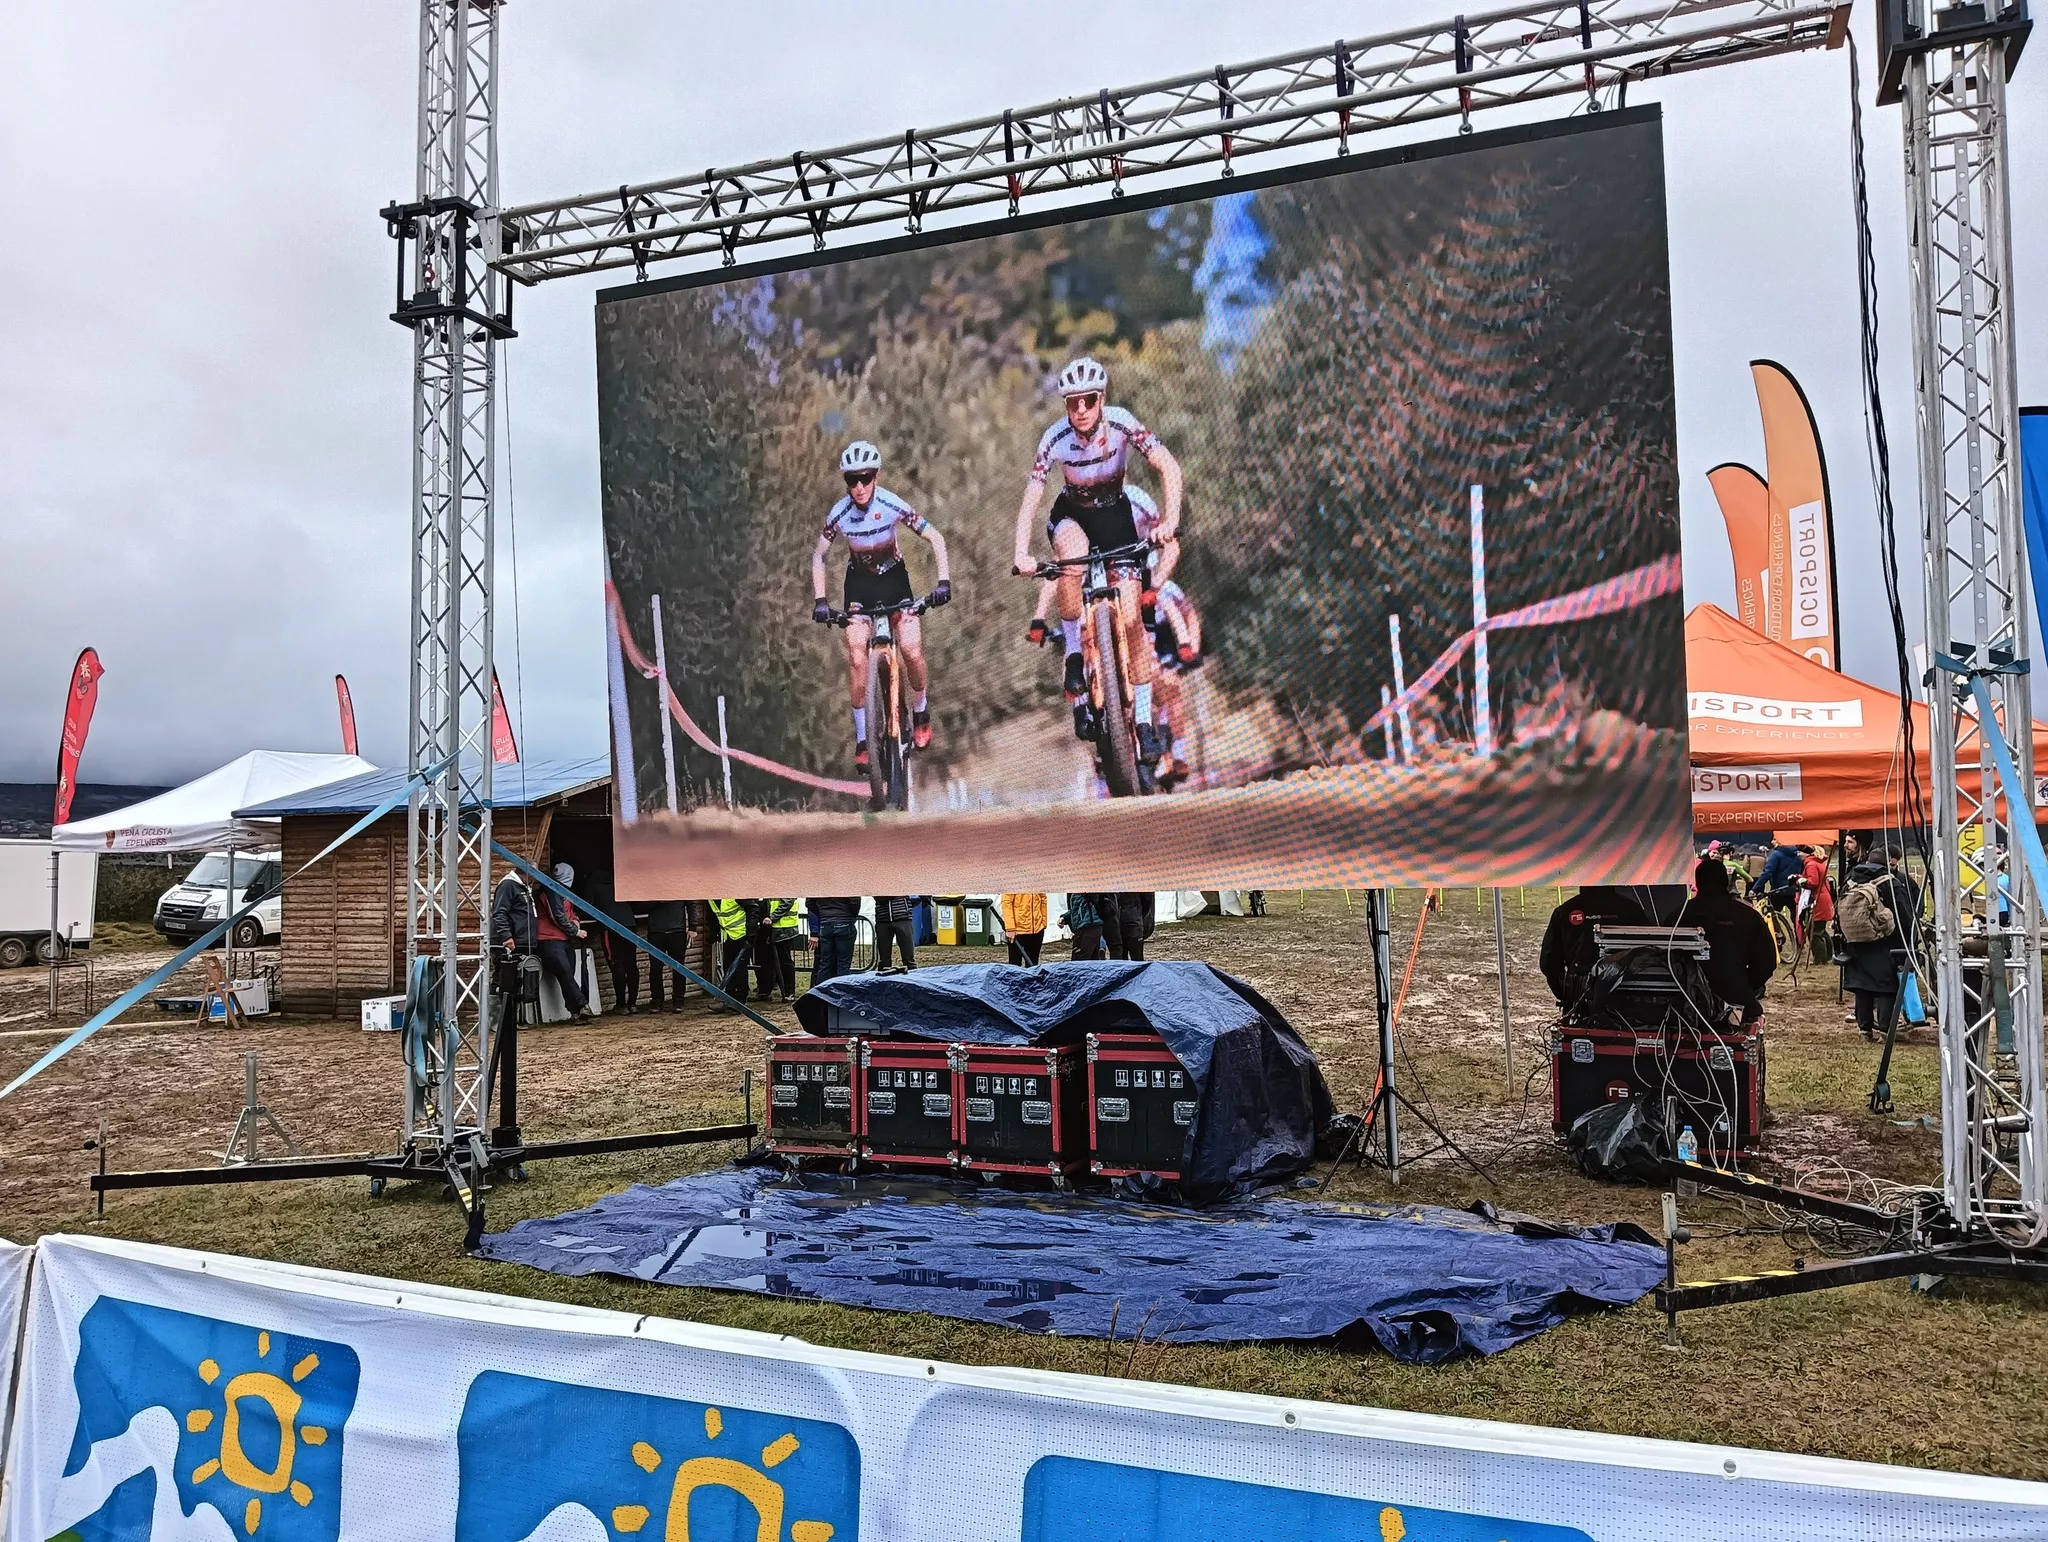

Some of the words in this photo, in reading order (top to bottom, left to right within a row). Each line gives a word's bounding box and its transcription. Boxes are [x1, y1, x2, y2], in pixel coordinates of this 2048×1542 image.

[1715, 724, 1866, 740] EXPERIENCES
[1709, 811, 1804, 825] EXPERIENCES
[125, 837, 168, 847] EDELWEISS
